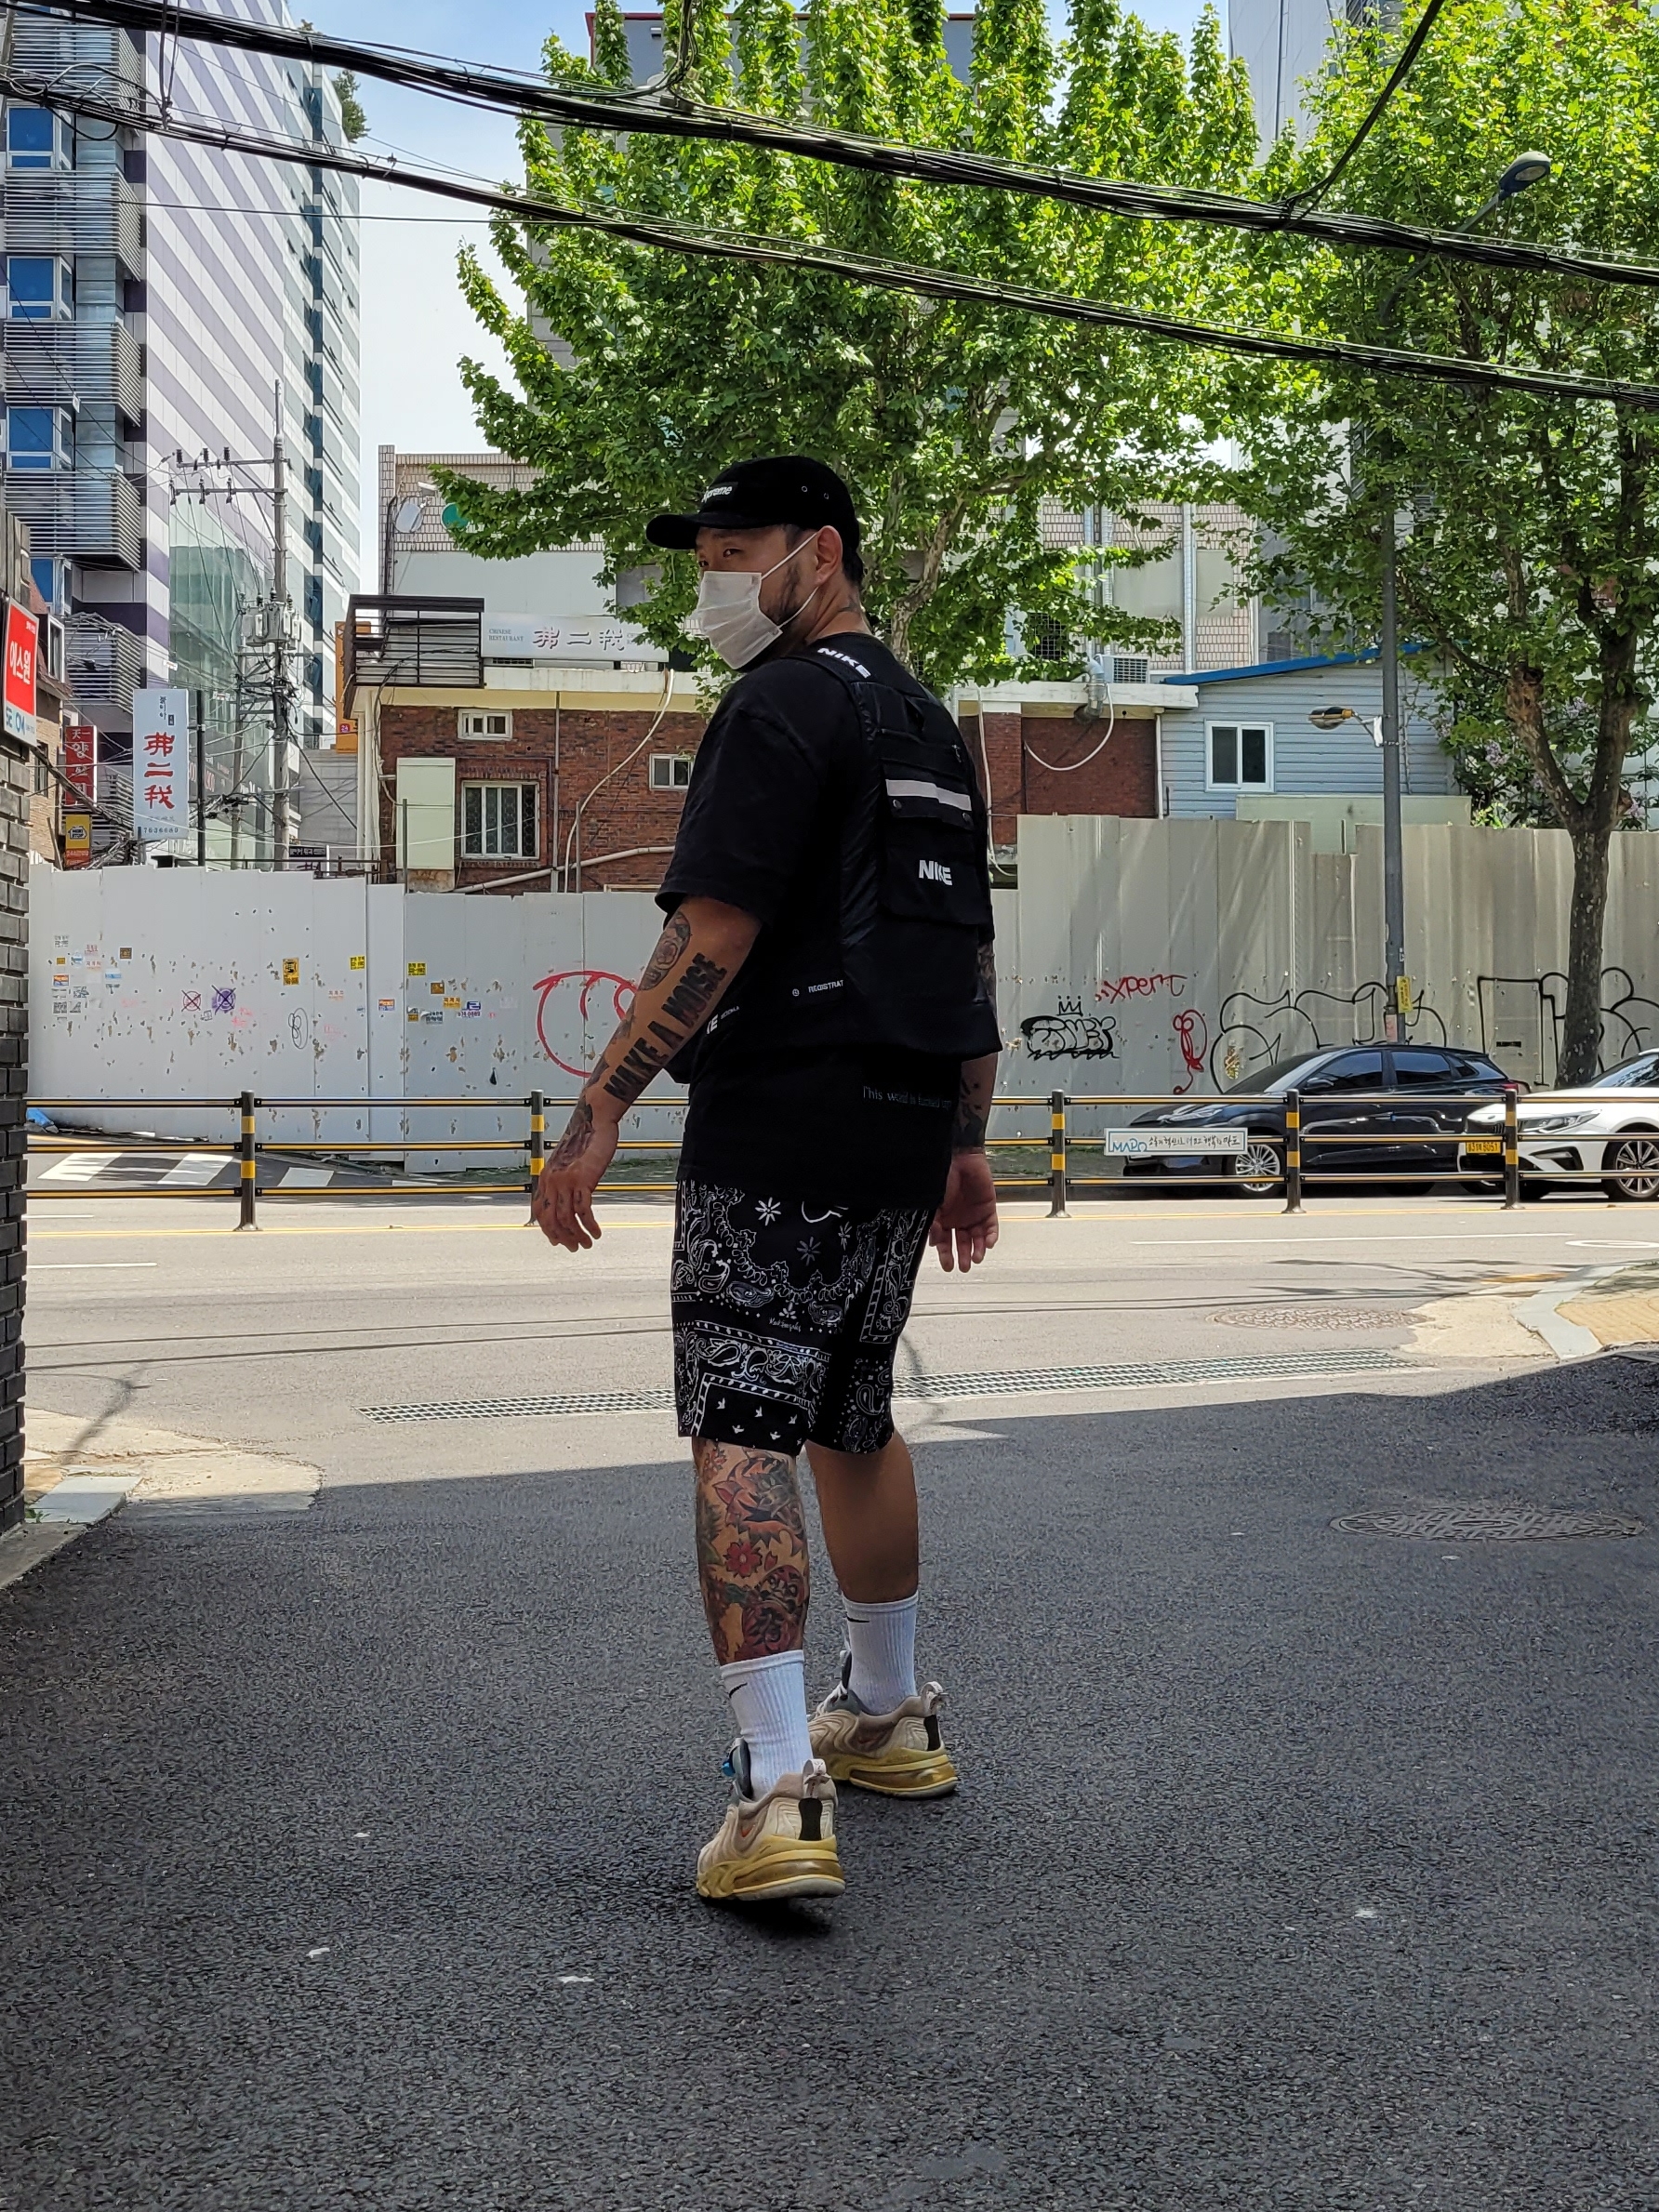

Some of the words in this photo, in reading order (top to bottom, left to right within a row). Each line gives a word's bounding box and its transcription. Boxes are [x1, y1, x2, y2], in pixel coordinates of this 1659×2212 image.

[816, 647, 871, 679] NIKE
[919, 859, 953, 886] NIKE
[661, 952, 728, 1029] NOISE
[647, 1020, 684, 1051] A
[603, 1037, 670, 1106] MAKE
[1112, 1137, 1148, 1152] MAPO
